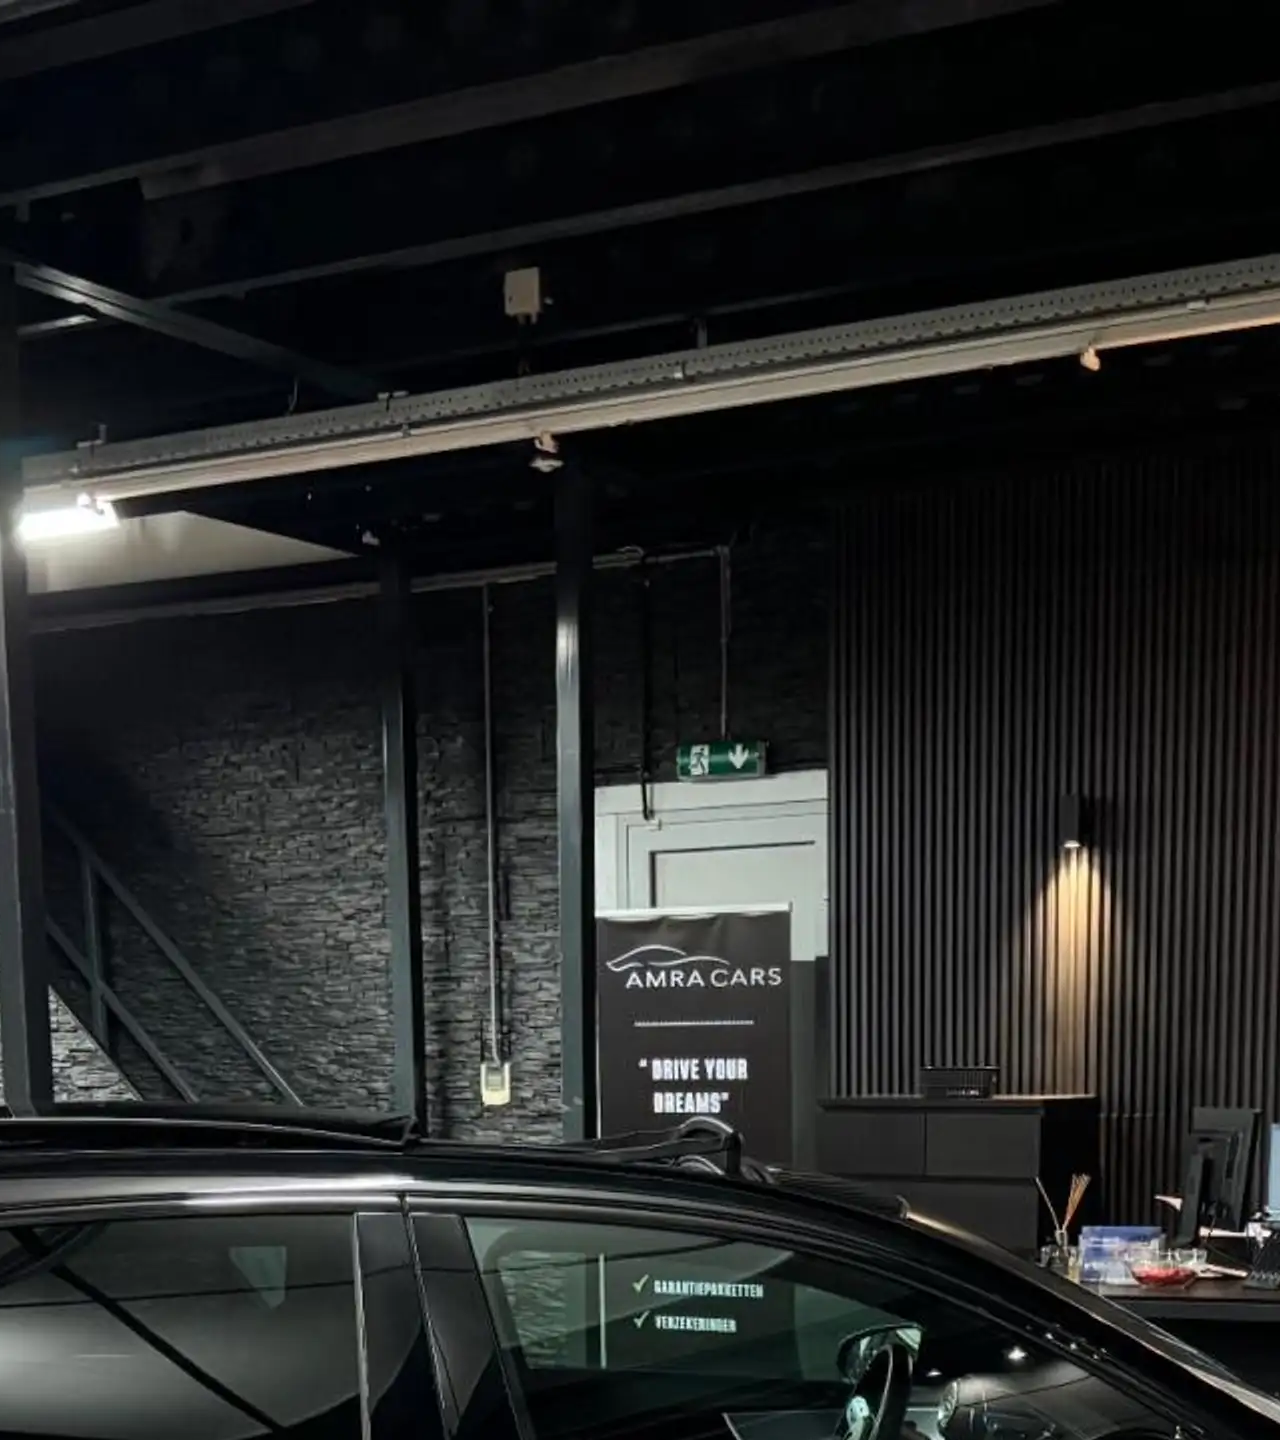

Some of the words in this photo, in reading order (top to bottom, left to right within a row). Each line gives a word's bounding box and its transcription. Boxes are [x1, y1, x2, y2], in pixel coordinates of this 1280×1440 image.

[625, 968, 706, 989] AMRA
[709, 967, 783, 988] CARS
[704, 1057, 749, 1081] YOUR
